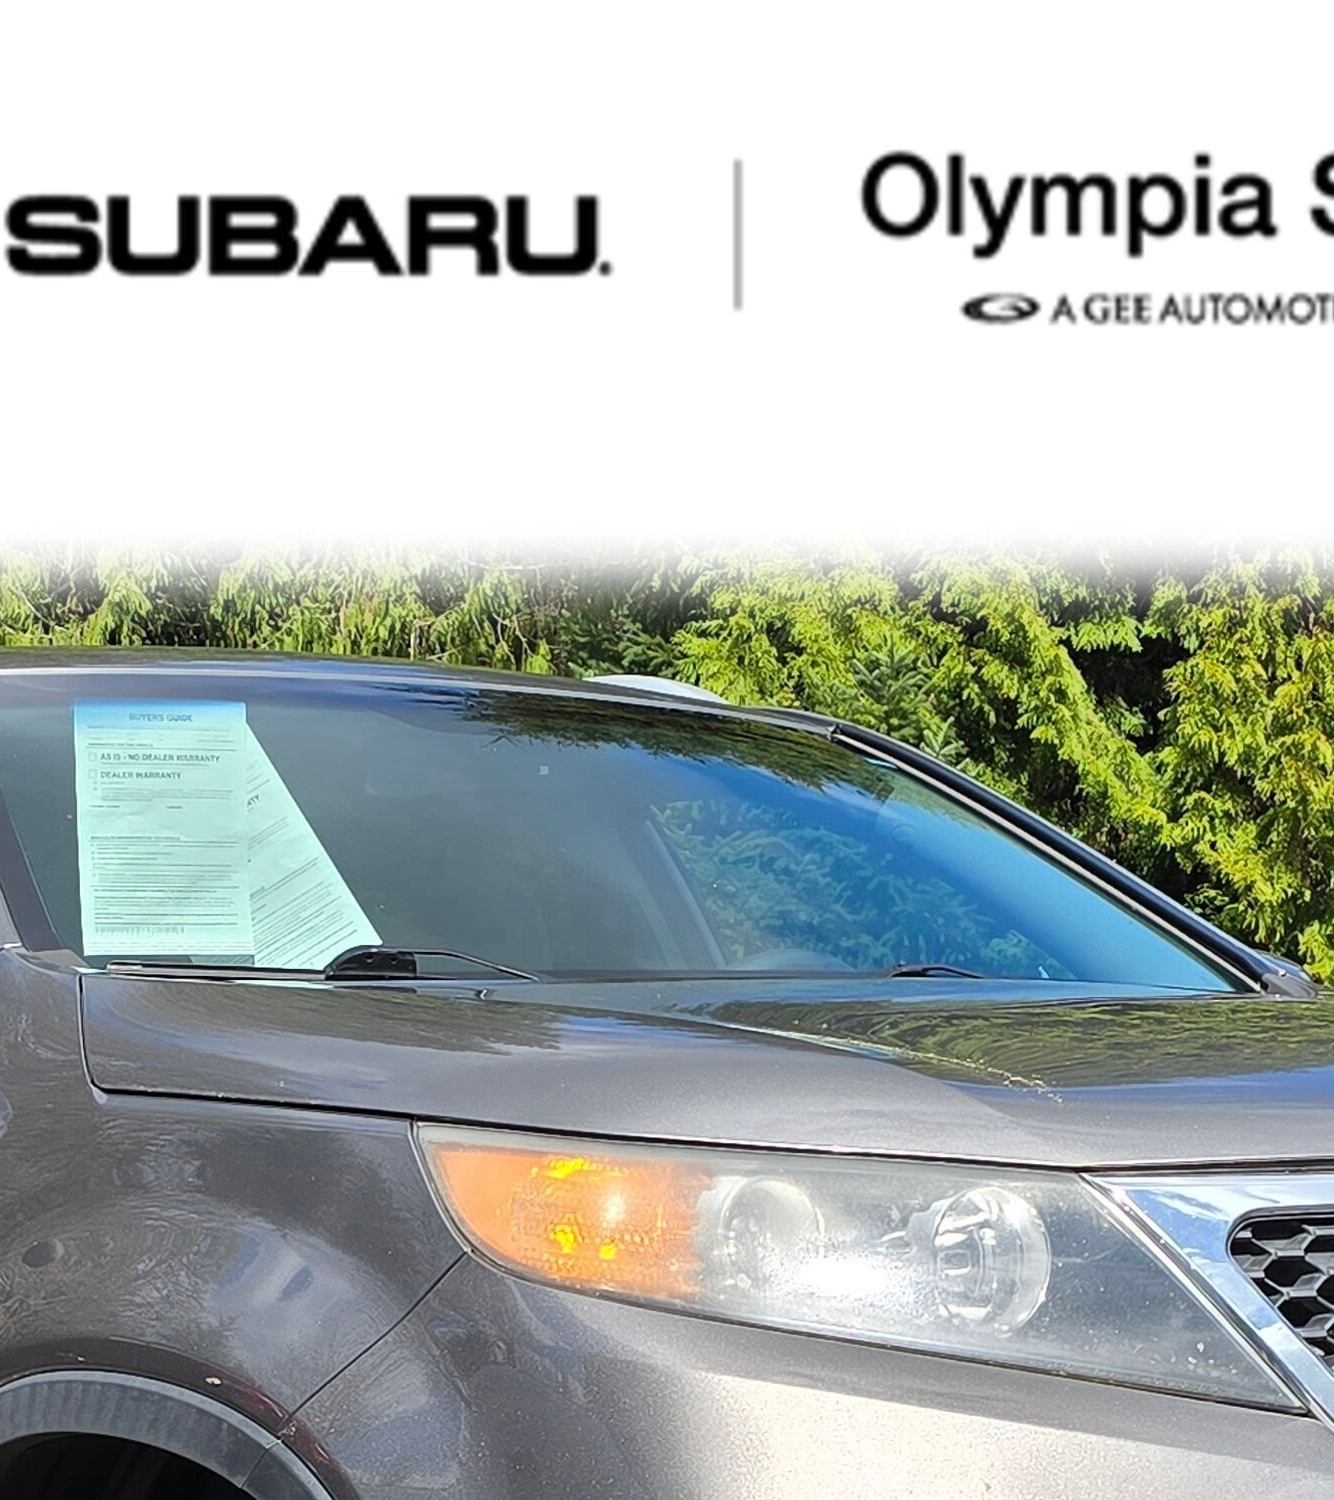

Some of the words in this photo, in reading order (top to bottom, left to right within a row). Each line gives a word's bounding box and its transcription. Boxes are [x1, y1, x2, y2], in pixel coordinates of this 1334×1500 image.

[142, 753, 175, 762] DEALER
[100, 771, 133, 779] DEALER
[136, 771, 182, 780] WARRANTY
